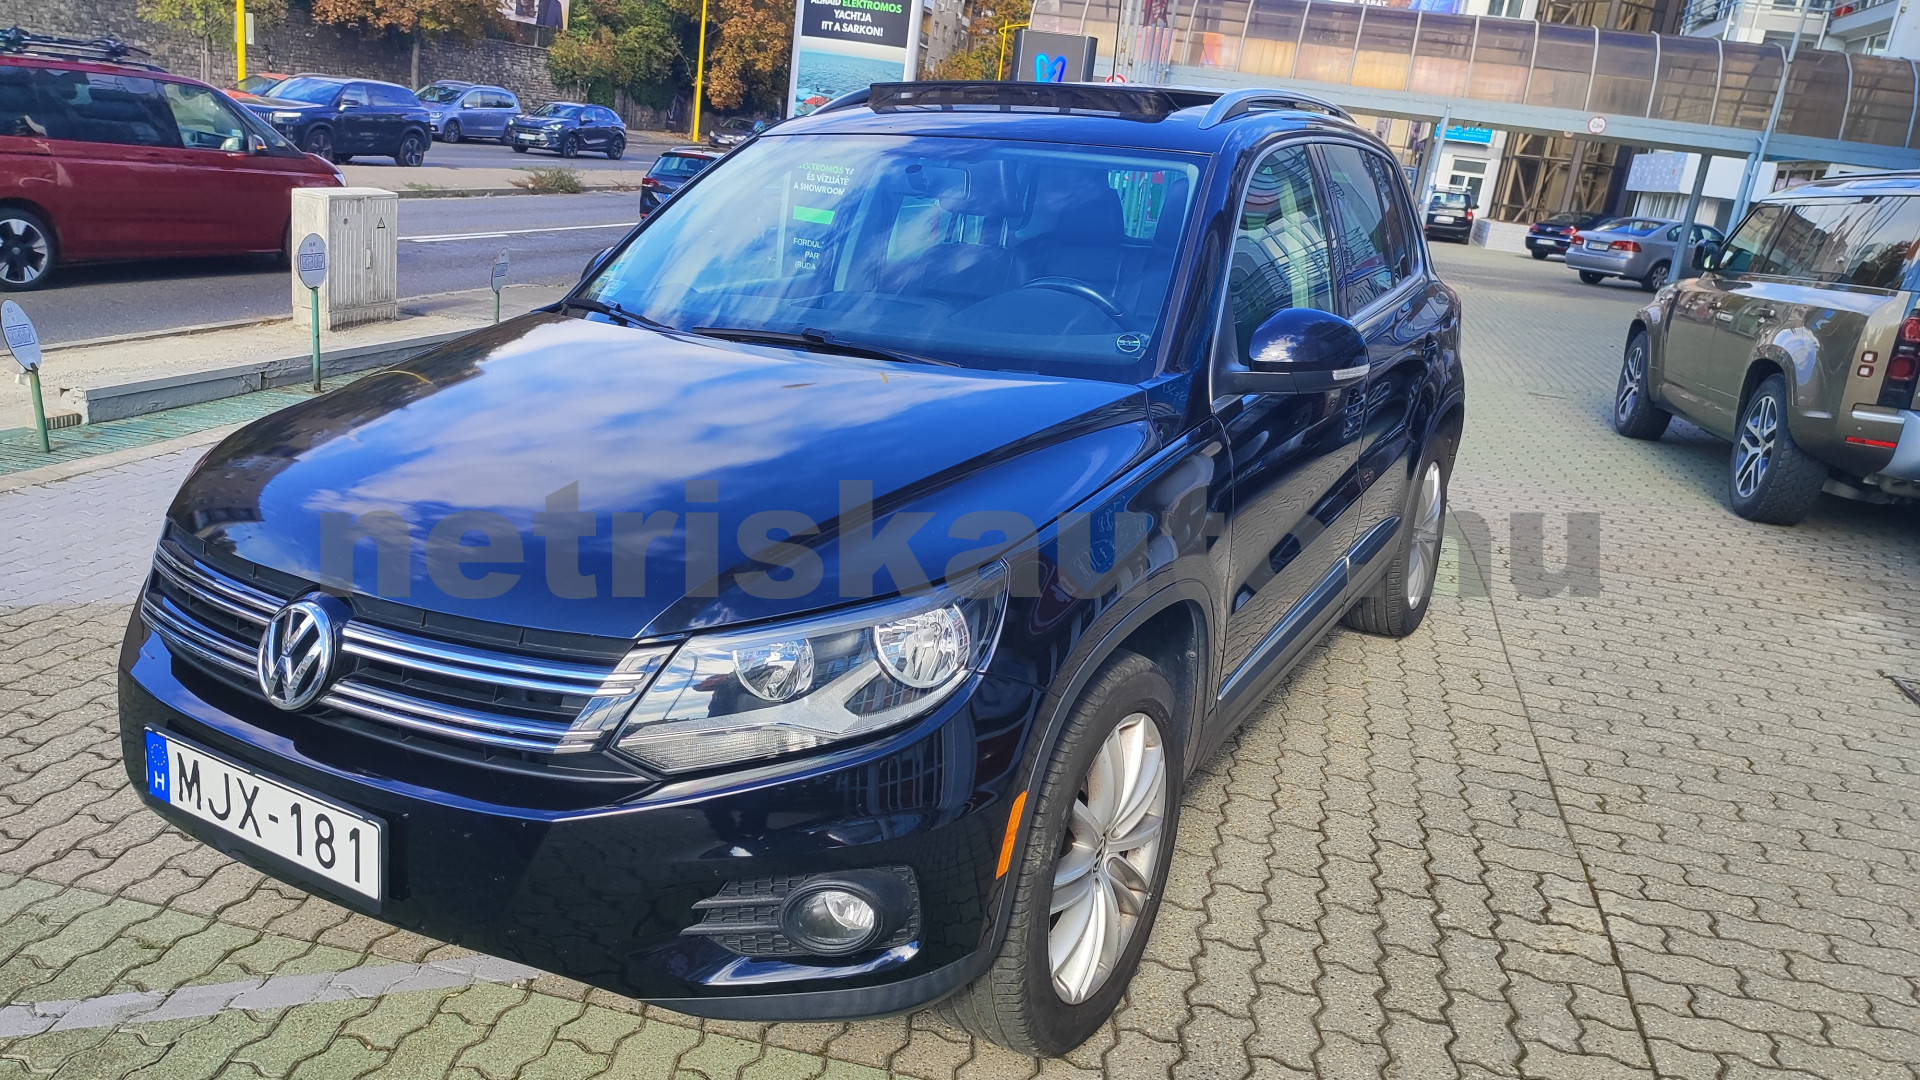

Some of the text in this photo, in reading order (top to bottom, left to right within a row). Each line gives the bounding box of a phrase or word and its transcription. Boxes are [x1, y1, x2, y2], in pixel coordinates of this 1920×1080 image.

[842, 0, 902, 13] ELEKTROMOS
[834, 9, 872, 22] YACHTJA
[834, 22, 841, 31] A
[842, 23, 884, 37] SARKON!
[807, 171, 815, 181] ÉS
[793, 182, 799, 190] A
[793, 238, 825, 248] FORDUL
[154, 770, 165, 791] H
[177, 752, 361, 883] MJX-181
